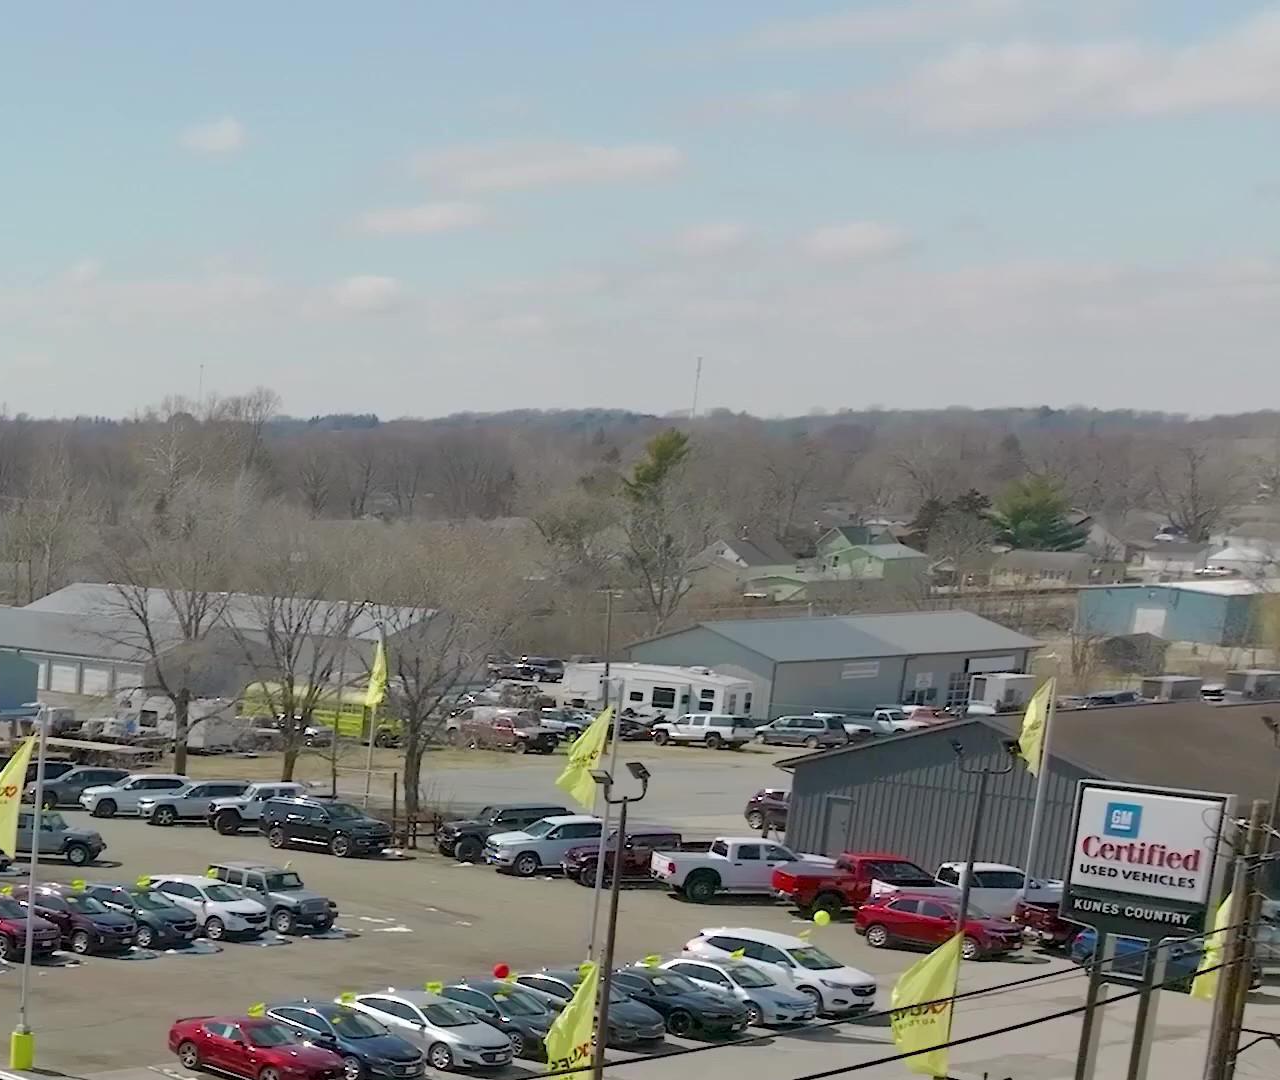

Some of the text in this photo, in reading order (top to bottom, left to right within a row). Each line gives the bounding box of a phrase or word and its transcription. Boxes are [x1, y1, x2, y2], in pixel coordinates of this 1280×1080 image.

[1111, 809, 1134, 827] GM
[1082, 835, 1201, 872] Certified
[1080, 863, 1196, 889] USED VEHICLES
[1074, 898, 1191, 925] KUNES COUNTRY
